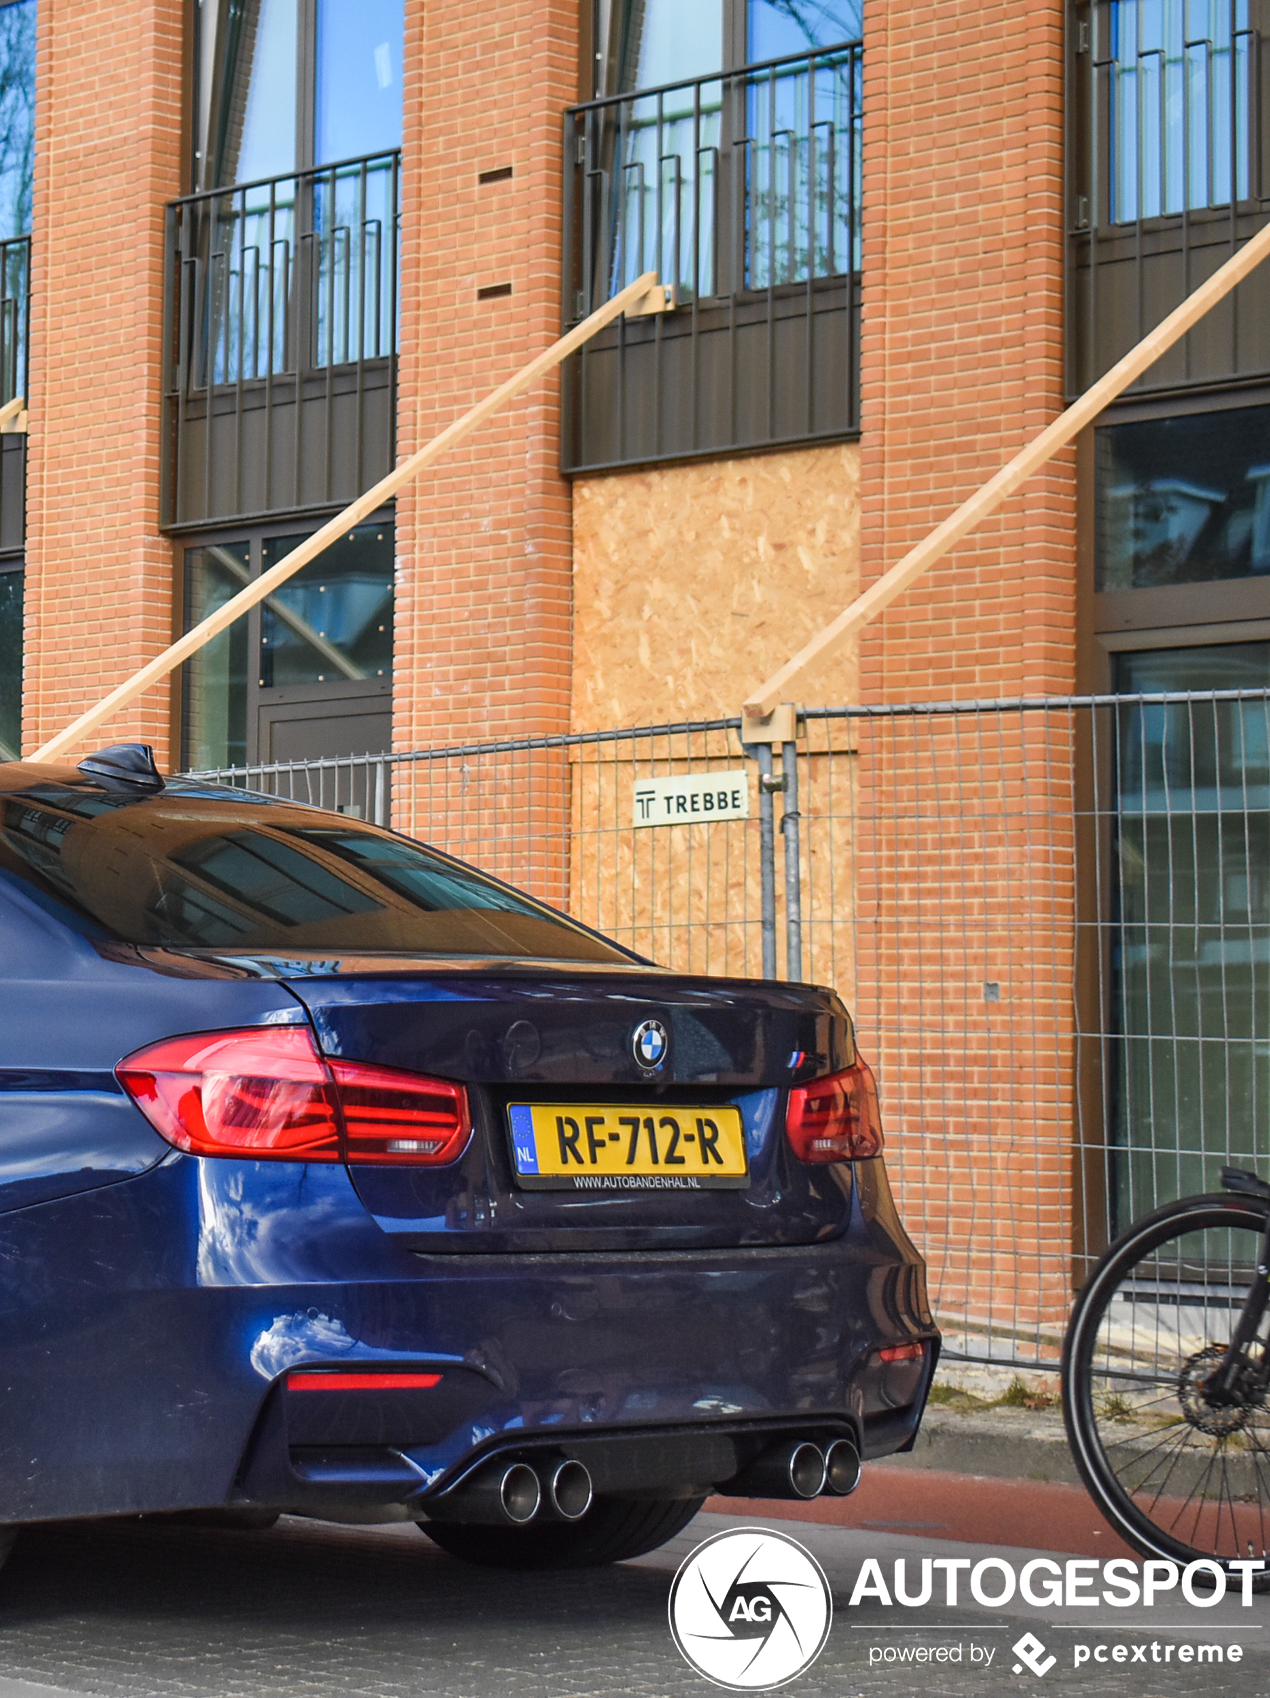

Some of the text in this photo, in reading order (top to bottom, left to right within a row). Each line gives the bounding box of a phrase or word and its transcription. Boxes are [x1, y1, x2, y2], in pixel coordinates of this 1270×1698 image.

[663, 790, 741, 814] TREBBE
[555, 1115, 724, 1164] RF-712-R
[517, 1147, 534, 1162] NL
[573, 1176, 701, 1188] WWW.AUTOBANDENHAL.NL
